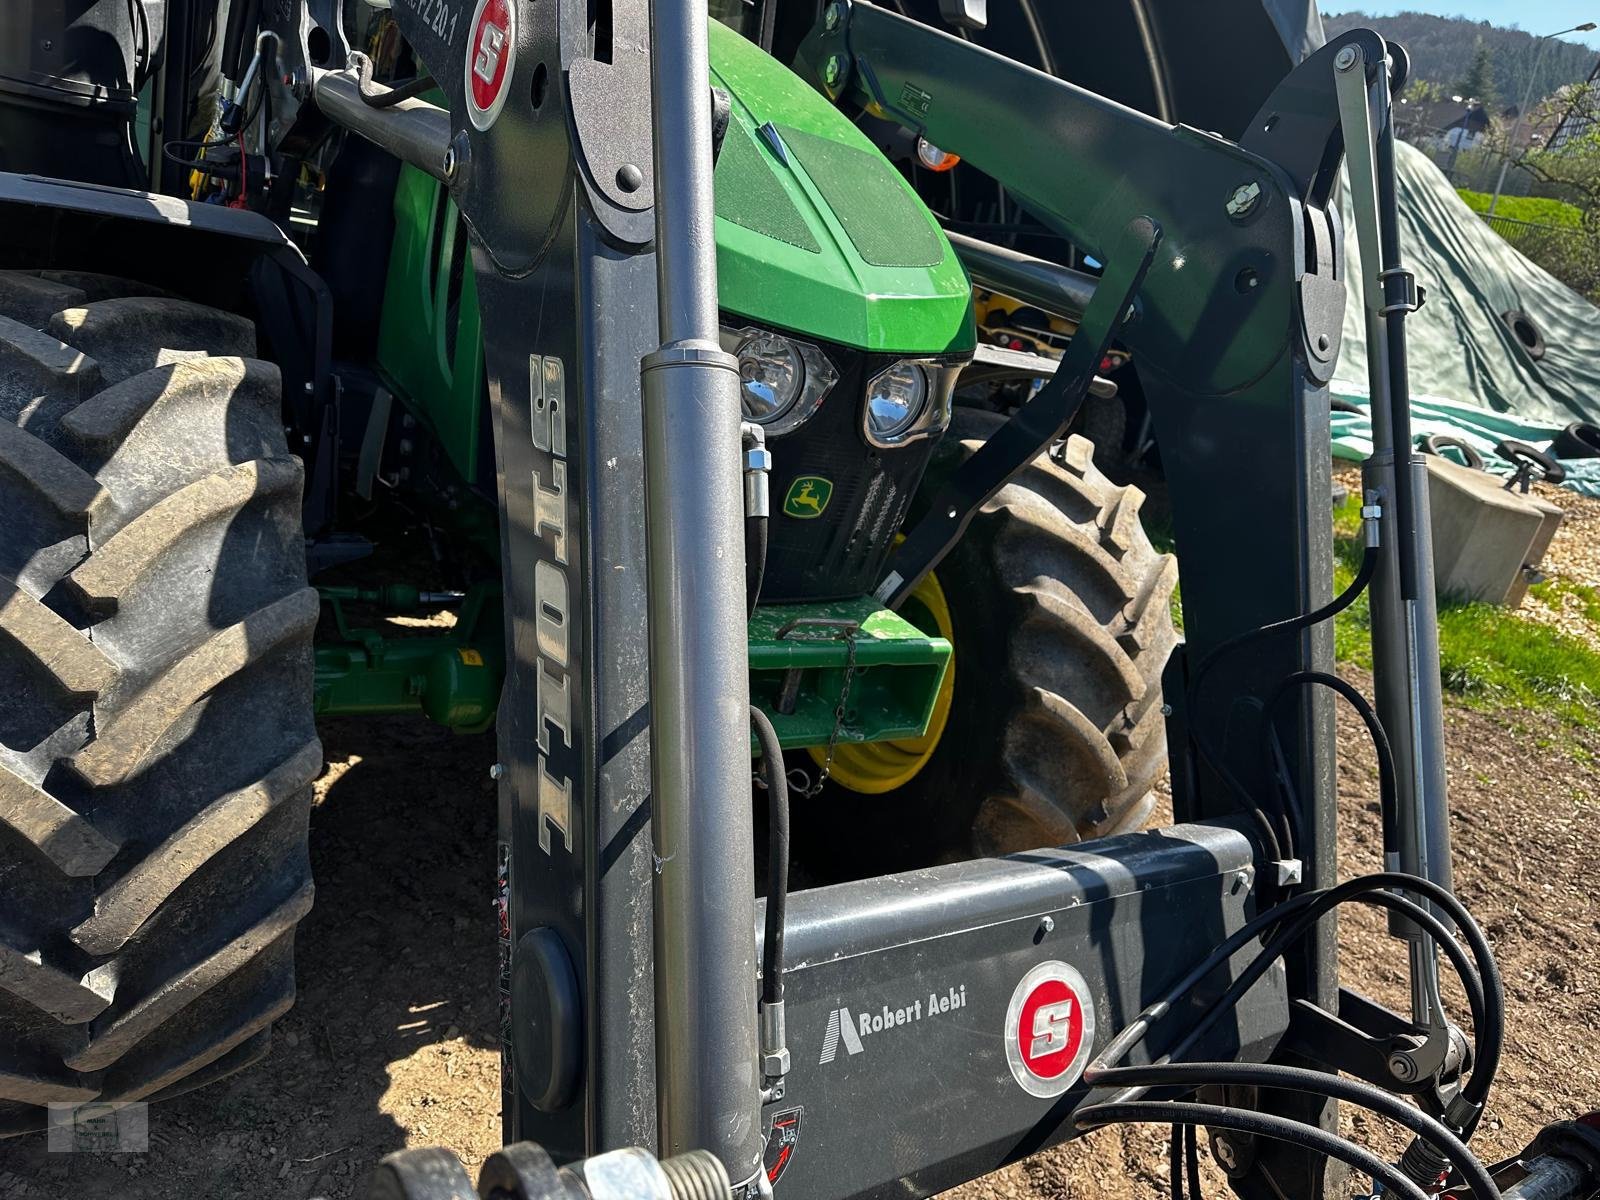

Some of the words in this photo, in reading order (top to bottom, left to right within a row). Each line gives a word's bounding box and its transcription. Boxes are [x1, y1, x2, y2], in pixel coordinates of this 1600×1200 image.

[431, 0, 458, 46] 20.1
[474, 21, 505, 85] S
[529, 353, 573, 856] STOLL
[859, 999, 922, 1037] Robert
[927, 984, 967, 1017] Aebi
[1029, 998, 1073, 1060] S
